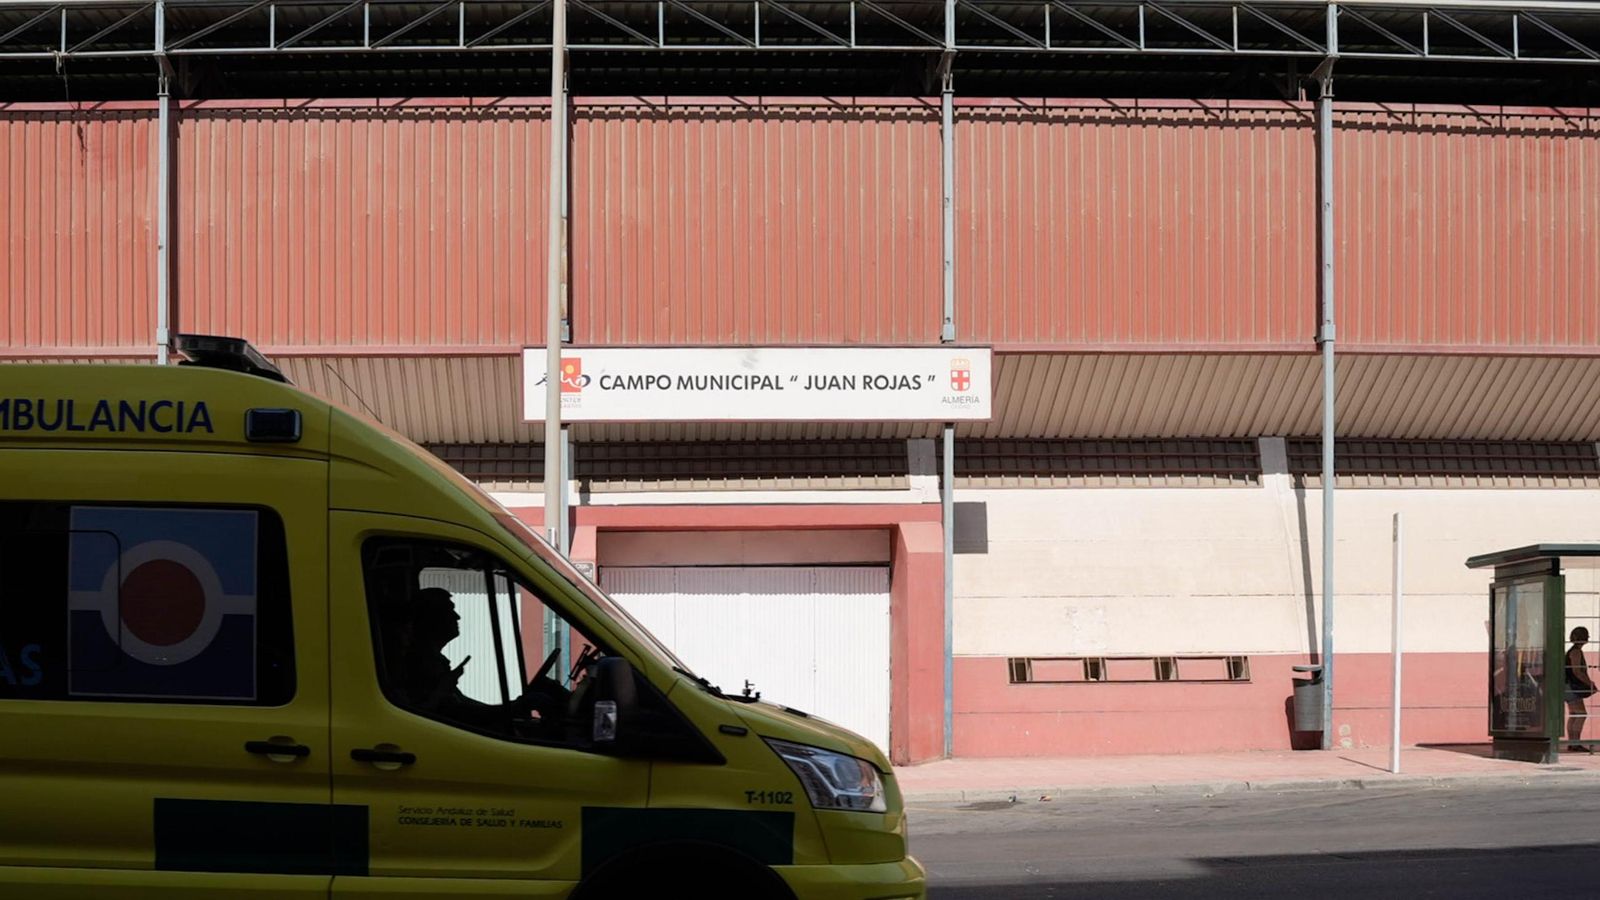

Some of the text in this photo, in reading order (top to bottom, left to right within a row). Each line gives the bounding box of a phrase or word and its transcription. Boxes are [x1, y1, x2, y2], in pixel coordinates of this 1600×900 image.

[599, 374, 672, 391] CAMPO
[676, 374, 784, 391] MUNICIPAL
[744, 790, 793, 804] T-1102
[398, 804, 515, 817] Servicio Andaluz de Salud
[460, 817, 473, 827] DE
[477, 817, 507, 828] SALUD
[510, 819, 517, 828] Y
[519, 819, 563, 829] FAMILIAS
